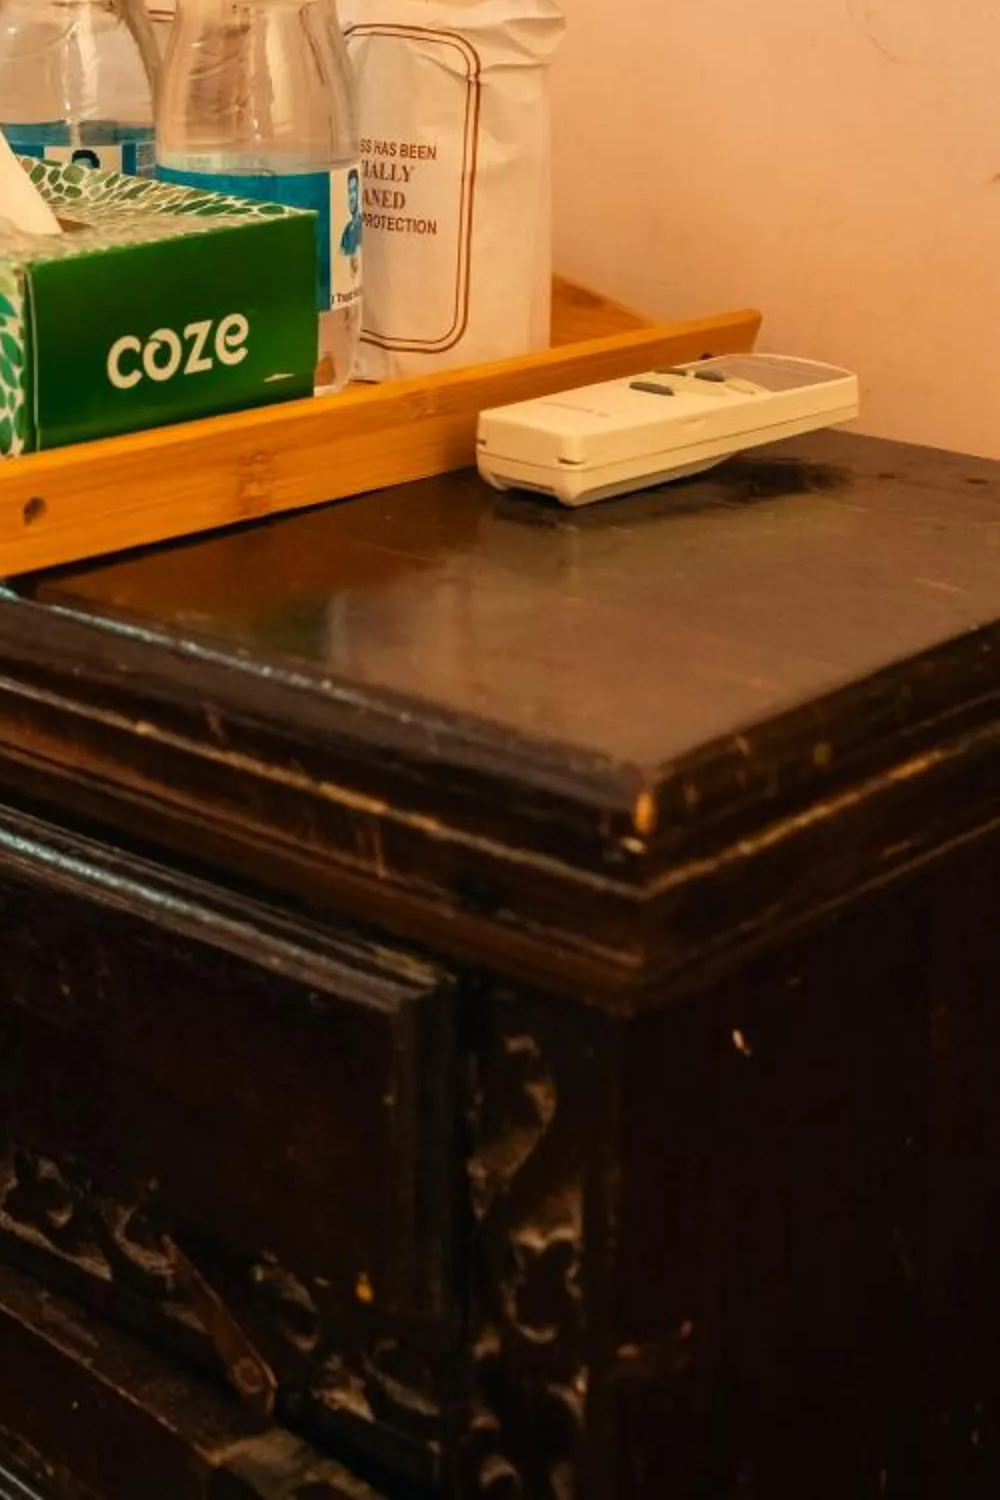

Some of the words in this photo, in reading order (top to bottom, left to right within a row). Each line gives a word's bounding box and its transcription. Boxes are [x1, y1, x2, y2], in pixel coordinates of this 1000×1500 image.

[374, 141, 397, 157] HAS
[400, 144, 437, 159] BEEN
[107, 313, 249, 389] coze
